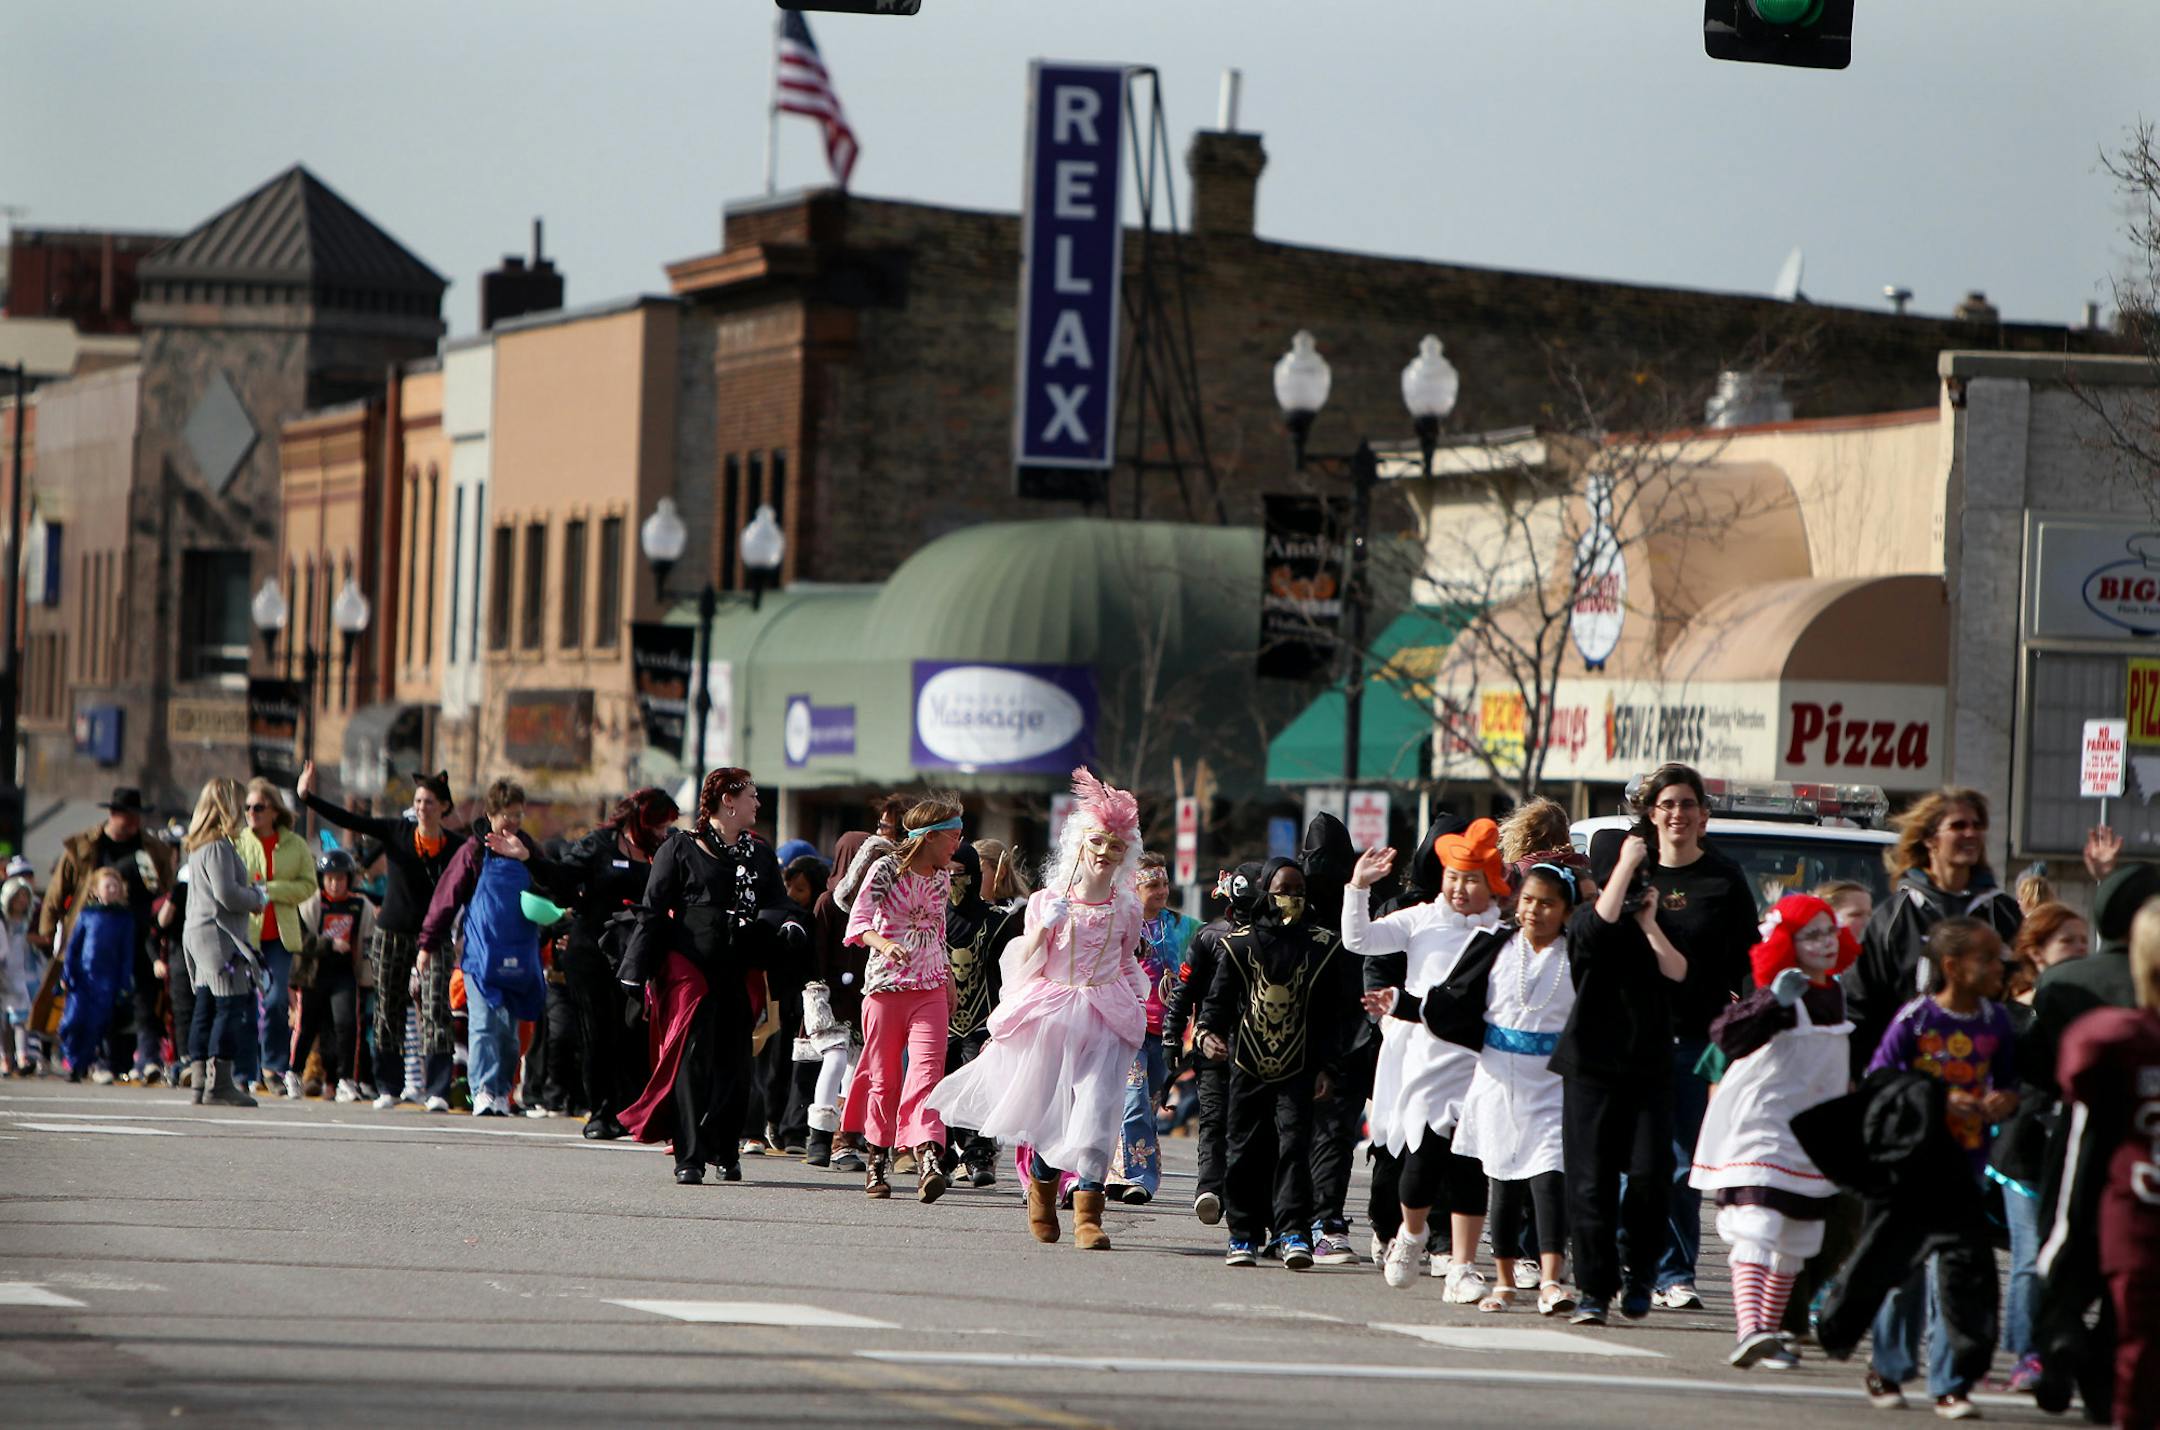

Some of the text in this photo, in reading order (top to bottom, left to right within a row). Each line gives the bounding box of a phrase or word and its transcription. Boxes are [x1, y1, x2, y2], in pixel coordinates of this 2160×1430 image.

[1041, 84, 1101, 444] RELAX
[2098, 576, 2160, 602] BIG
[929, 693, 1045, 741] Massage
[2127, 667, 2160, 738] PIZ
[1656, 704, 1706, 763] PRESS
[1784, 701, 1930, 769] Pizza
[2087, 739, 2121, 753] PARKING
[2099, 727, 2110, 740] NO
